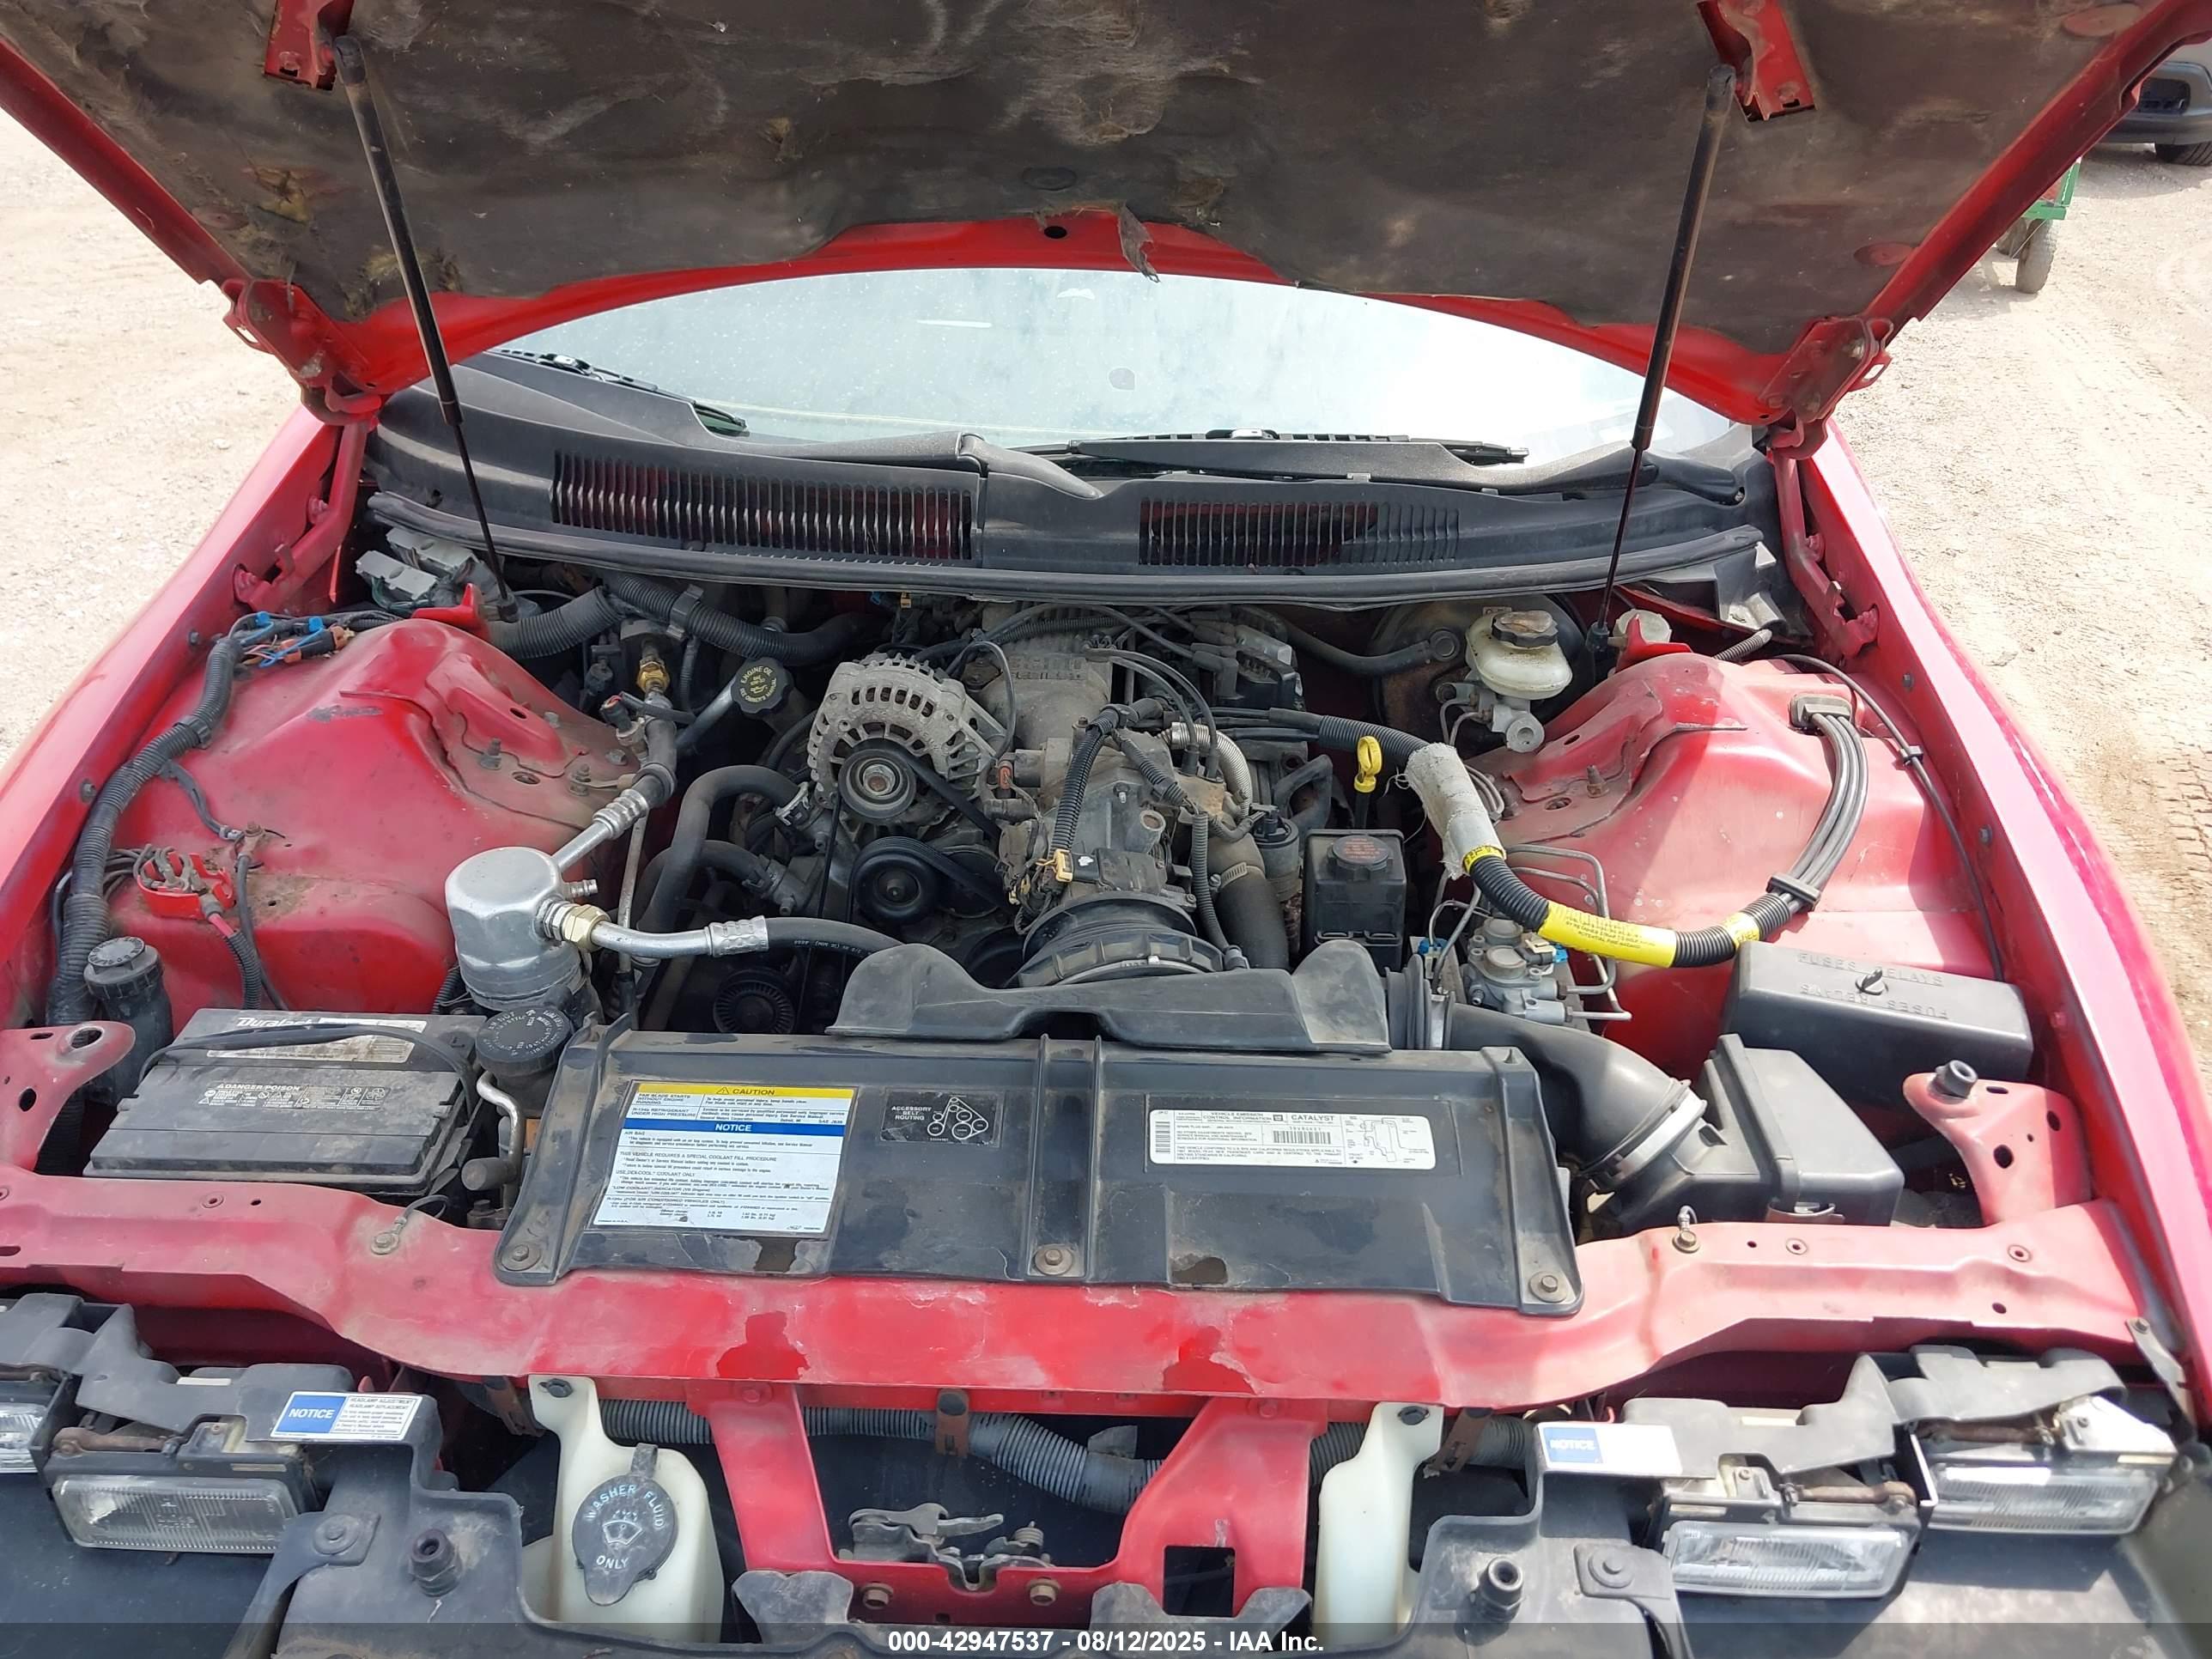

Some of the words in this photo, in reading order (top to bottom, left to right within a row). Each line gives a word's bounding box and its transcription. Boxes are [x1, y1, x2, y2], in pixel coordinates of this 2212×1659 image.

[741, 666, 763, 684] ENGINE
[763, 667, 773, 677] OIL
[1797, 952, 1857, 972] FUSES
[288, 1408, 335, 1419] NOTICE
[1550, 1439, 1595, 1451] NOTICE
[583, 1484, 637, 1522] WASHER
[643, 1491, 665, 1529] FLUID
[596, 1555, 629, 1570] ONLY
